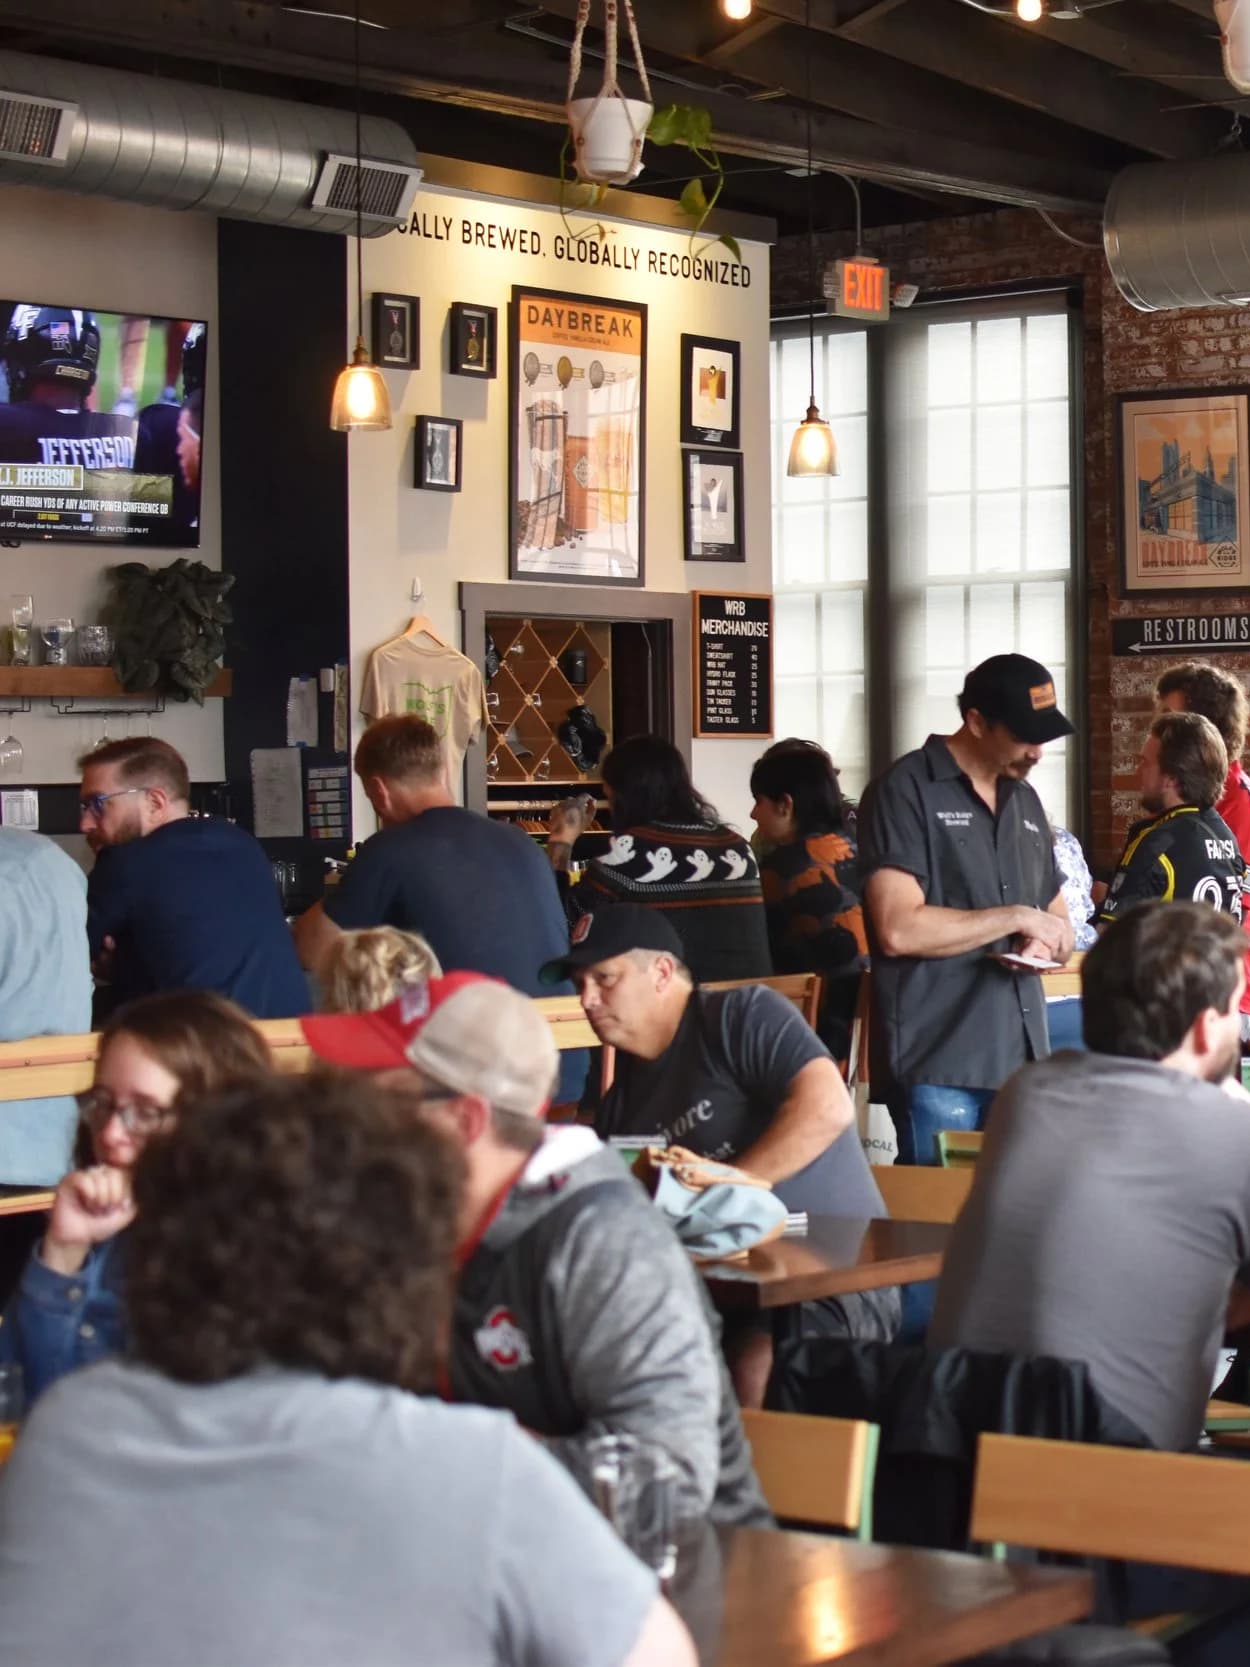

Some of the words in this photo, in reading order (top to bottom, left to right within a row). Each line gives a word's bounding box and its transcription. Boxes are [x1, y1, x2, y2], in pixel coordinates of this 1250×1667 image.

[399, 211, 453, 241] CALLY
[553, 235, 640, 271] GLOBALLY
[648, 251, 751, 289] RECOGNIZED
[844, 263, 884, 310] EXIT
[527, 304, 633, 338] DAYBREAK
[16, 467, 75, 487] JEFFERSON
[0, 495, 25, 507] CAREER
[65, 498, 78, 510] ANY
[78, 499, 100, 512] ACTIVE
[122, 501, 159, 514] CONFERENCE
[724, 599, 746, 616] WRB
[701, 618, 769, 637] MERCHANDISE
[1143, 616, 1249, 642] RESTROOMS
[860, 1137, 894, 1153] OCAL
